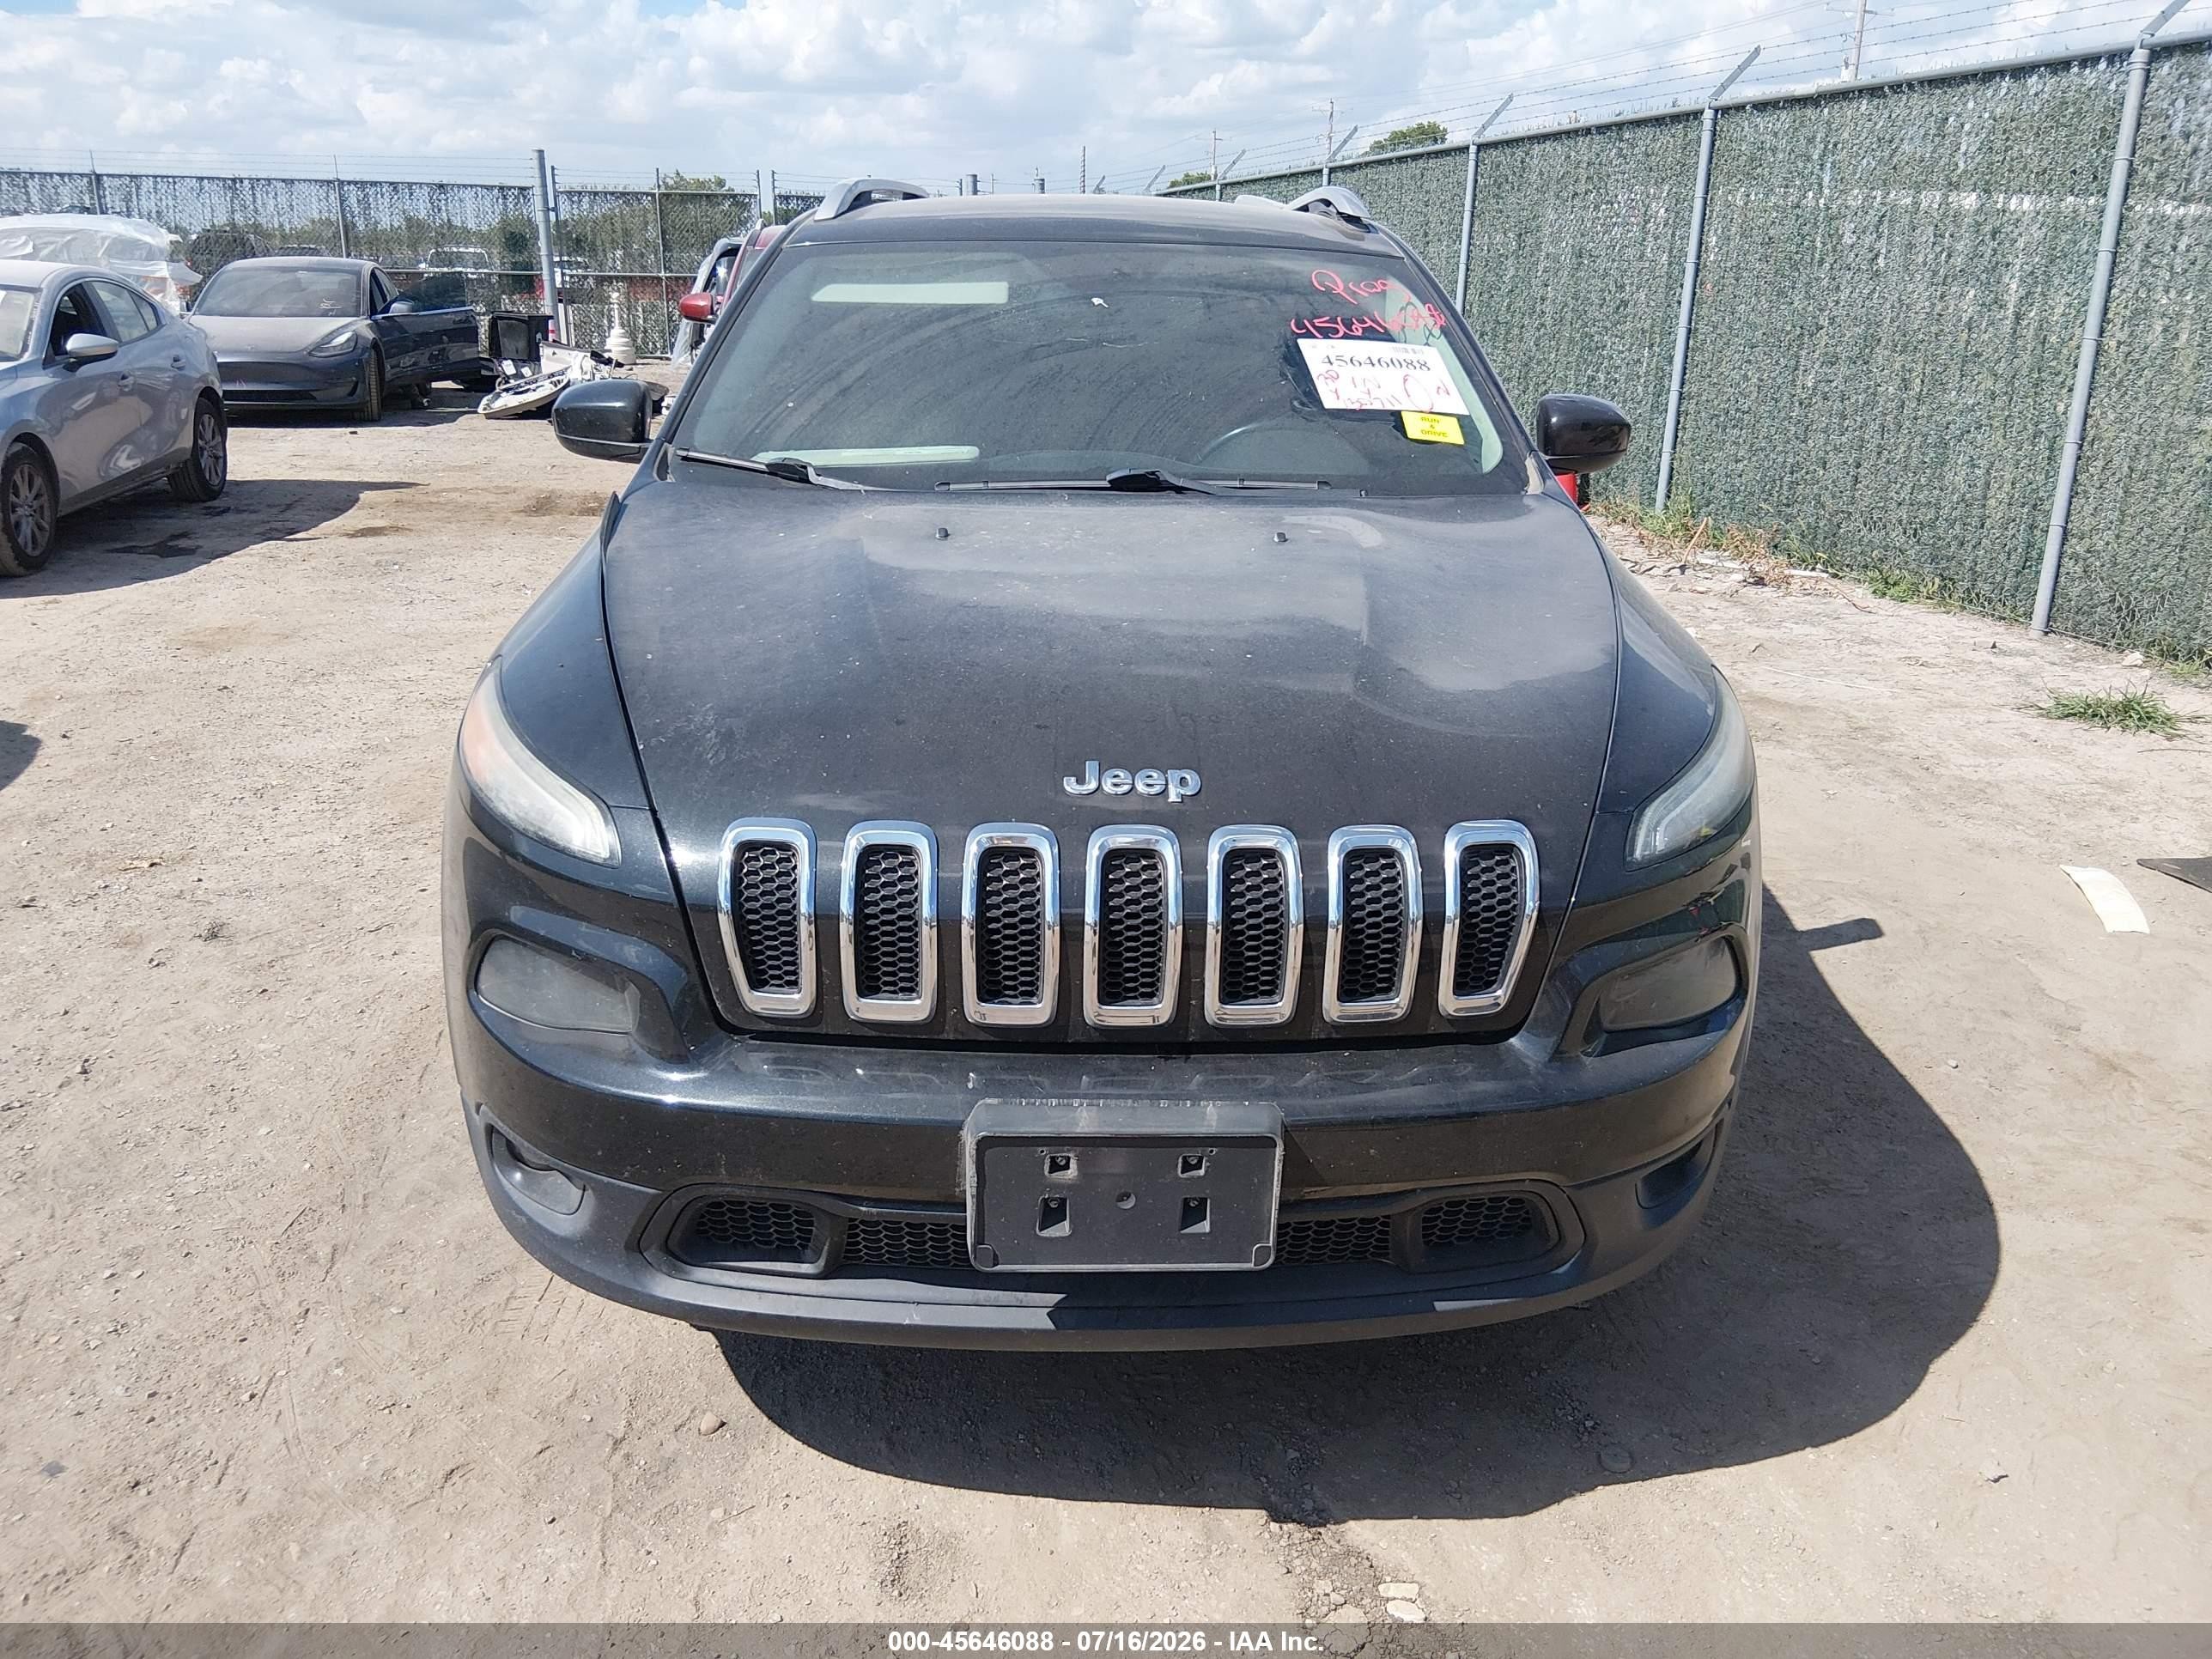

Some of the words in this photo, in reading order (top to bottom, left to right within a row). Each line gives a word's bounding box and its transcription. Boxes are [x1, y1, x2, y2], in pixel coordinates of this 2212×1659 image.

[1321, 354, 1431, 372] 45646088
[1420, 429, 1449, 438] DRIVE
[1063, 760, 1201, 802] Jeep
